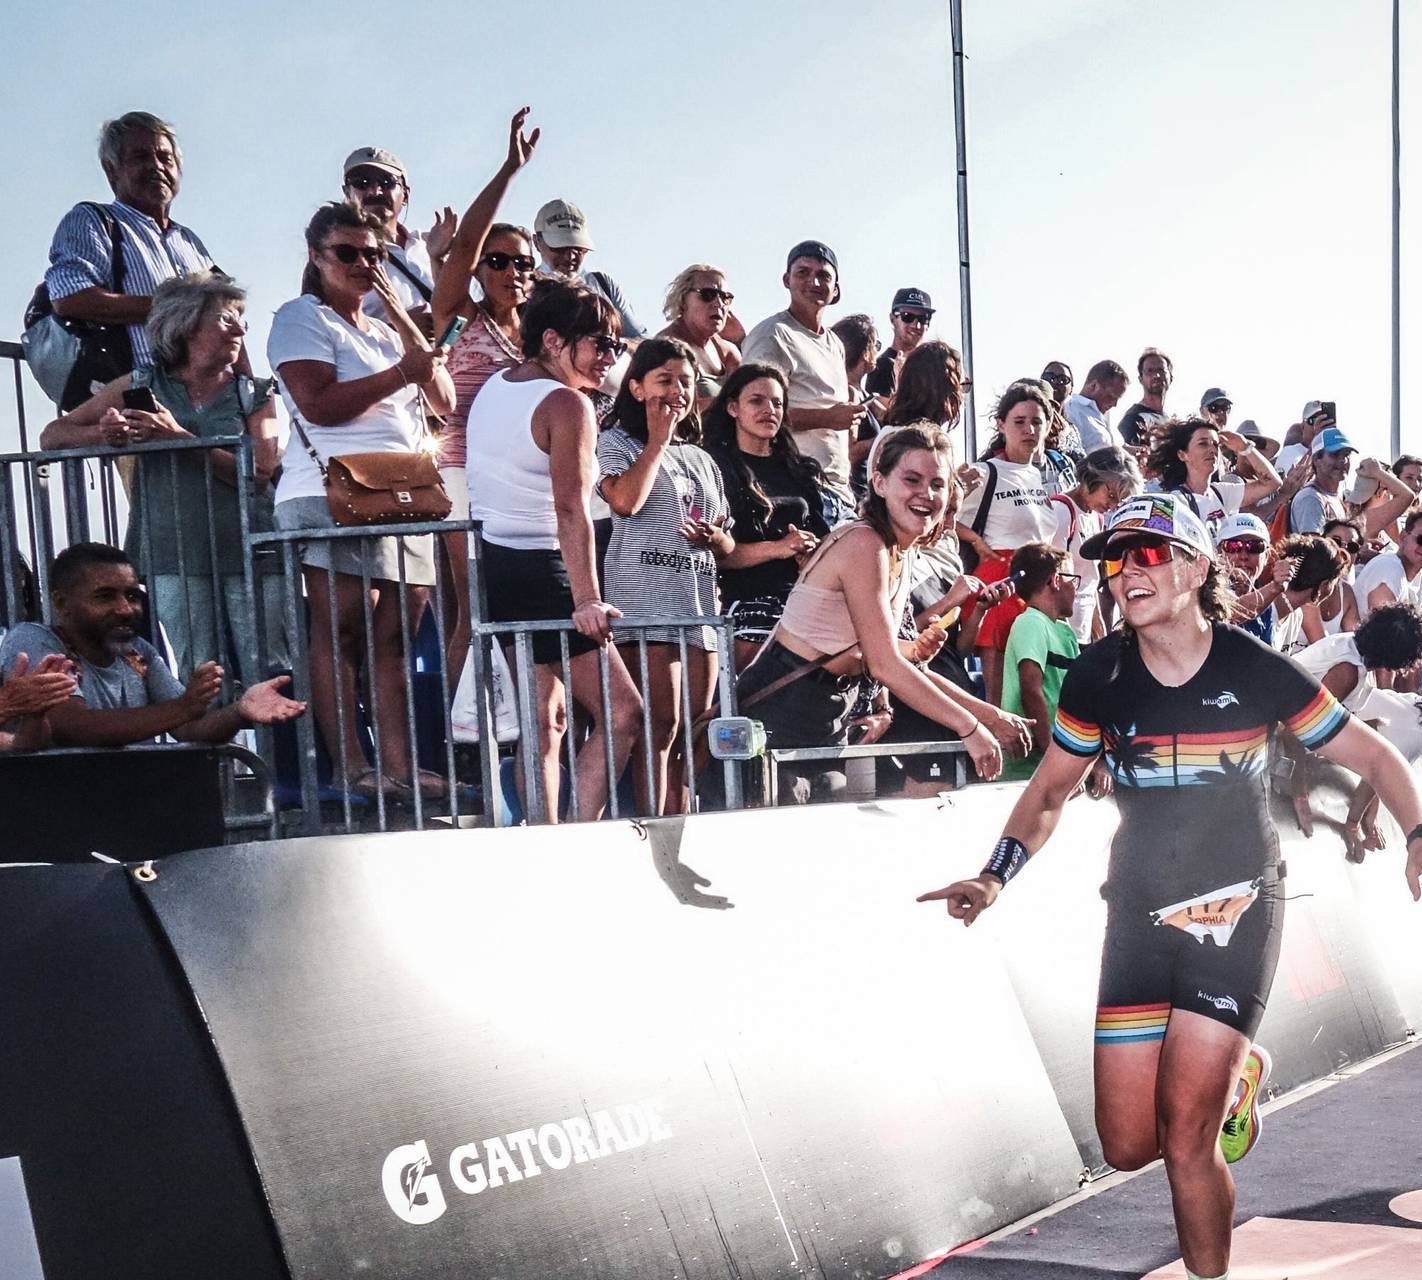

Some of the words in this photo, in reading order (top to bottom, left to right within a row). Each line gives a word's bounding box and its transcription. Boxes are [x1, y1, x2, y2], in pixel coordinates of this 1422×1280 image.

[995, 489, 1021, 500] TEAM
[1197, 990, 1235, 1009] kiwami
[381, 1139, 447, 1225] G
[449, 1101, 673, 1195] GATORADE
